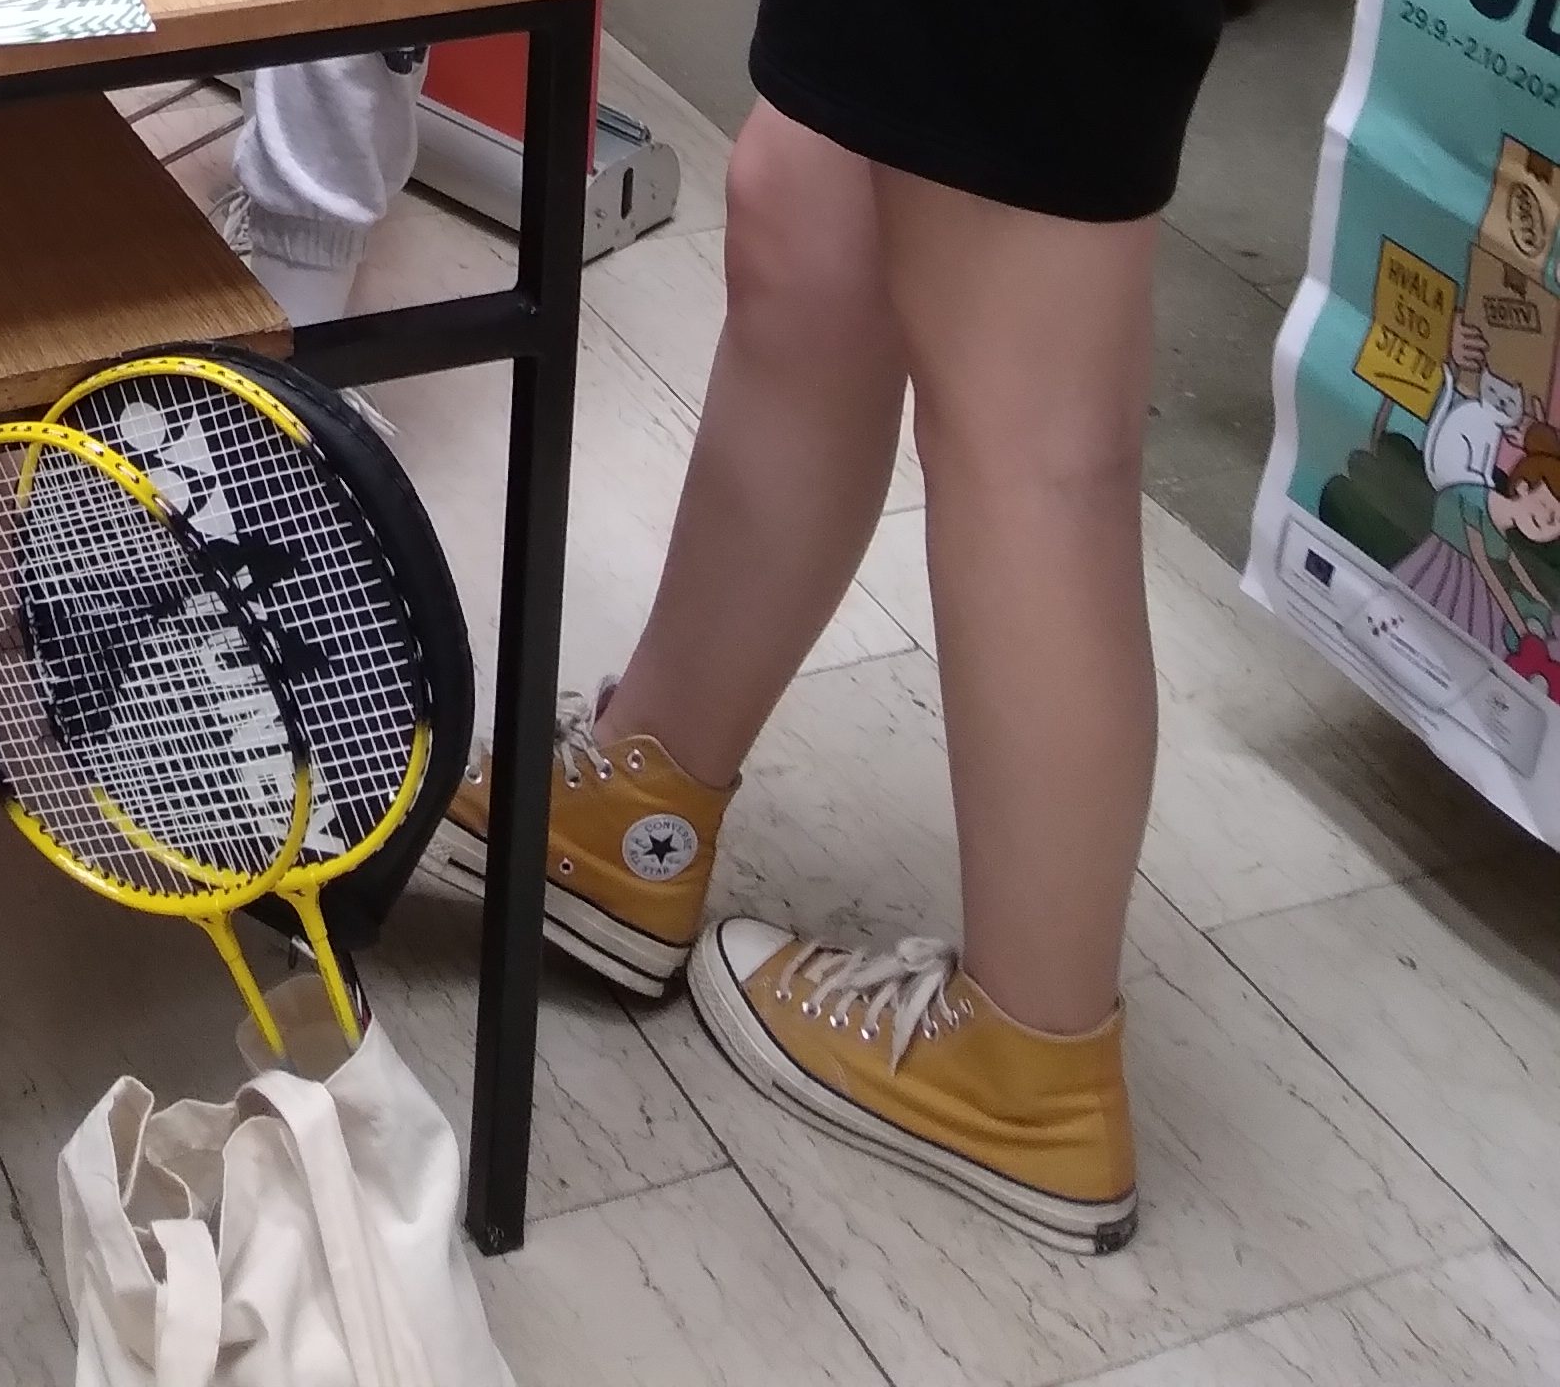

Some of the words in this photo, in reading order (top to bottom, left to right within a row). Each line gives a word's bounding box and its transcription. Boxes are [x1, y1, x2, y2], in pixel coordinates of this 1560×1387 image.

[1387, 256, 1444, 315] HVALA
[1395, 293, 1431, 340] ŠTO
[1375, 323, 1410, 365] STE
[1412, 346, 1437, 381] TU
